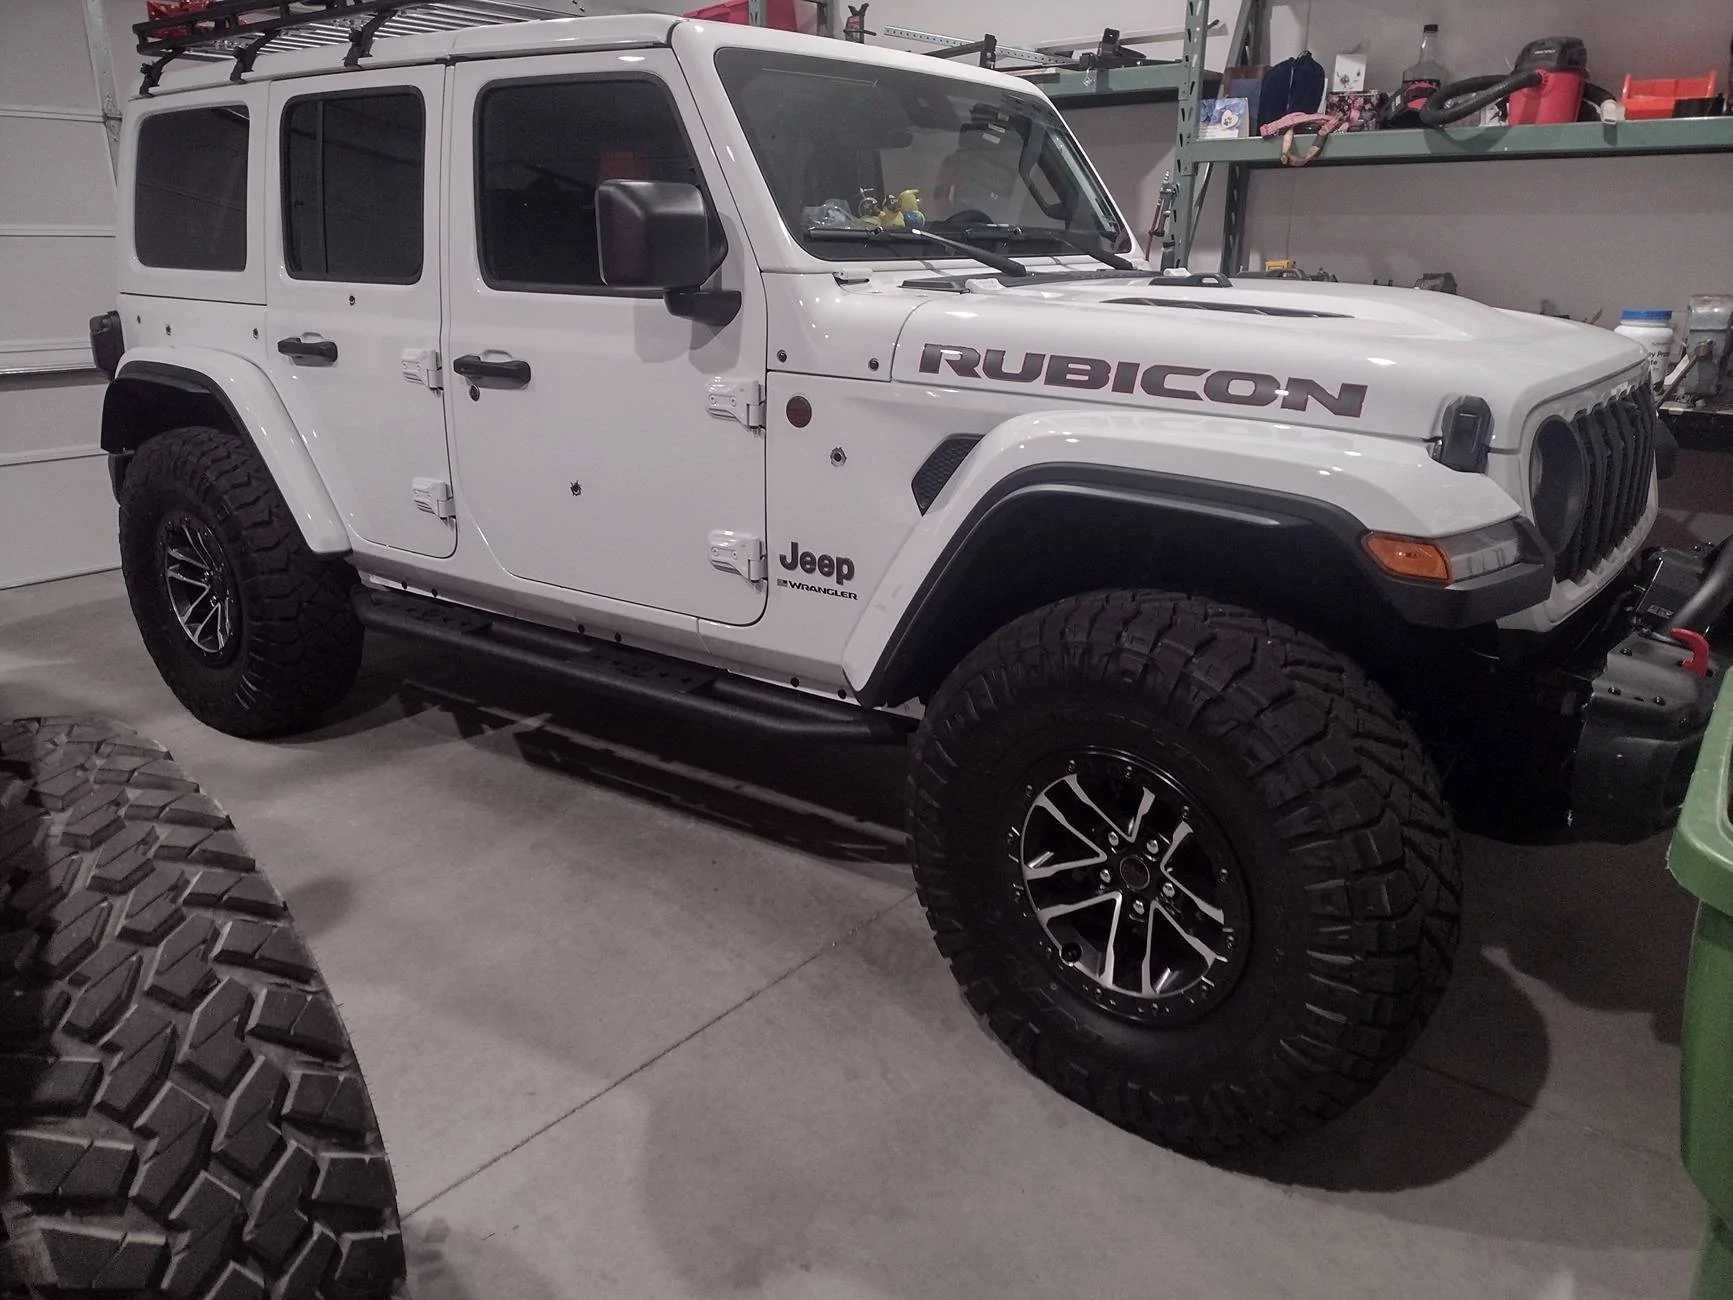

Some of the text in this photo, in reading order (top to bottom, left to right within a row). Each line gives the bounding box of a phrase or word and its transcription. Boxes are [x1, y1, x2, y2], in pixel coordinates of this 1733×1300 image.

[919, 343, 1368, 417] RUBICON
[779, 541, 855, 586] Jeep
[789, 580, 858, 600] WRANGLER
